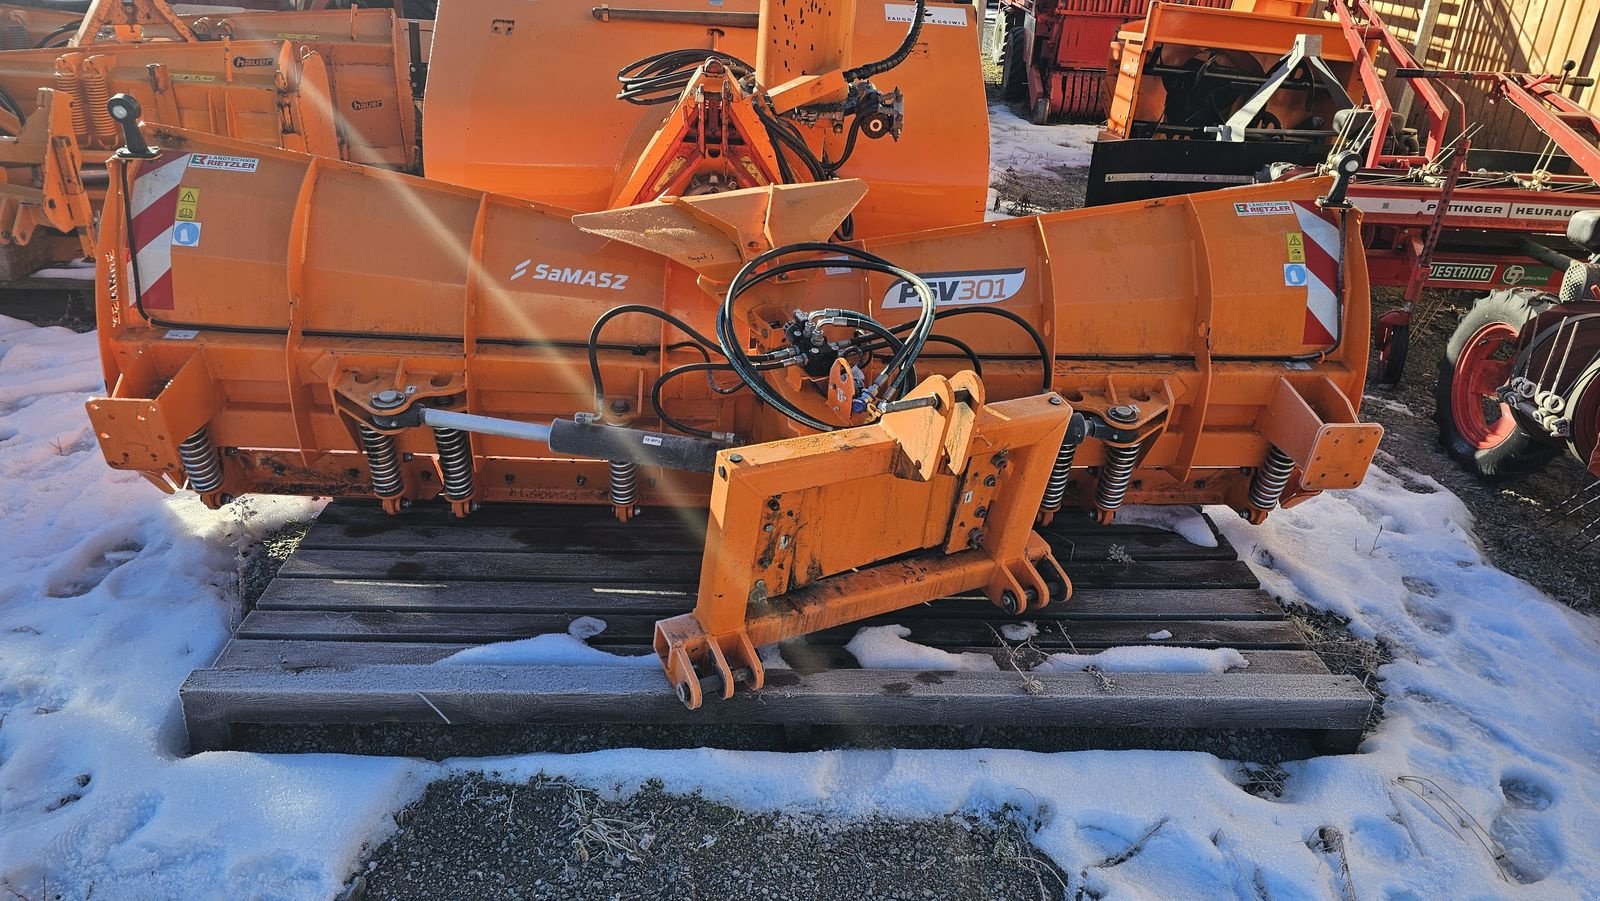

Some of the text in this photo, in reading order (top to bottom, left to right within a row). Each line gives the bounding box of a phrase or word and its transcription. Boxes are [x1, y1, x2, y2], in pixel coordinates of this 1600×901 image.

[234, 57, 273, 67] hauer
[353, 100, 382, 110] hauer
[208, 155, 256, 163] LANDTECHNIK
[207, 160, 255, 169] RIETZLER
[1427, 204, 1503, 214] PTTINGER
[532, 263, 629, 290] SaMASZ
